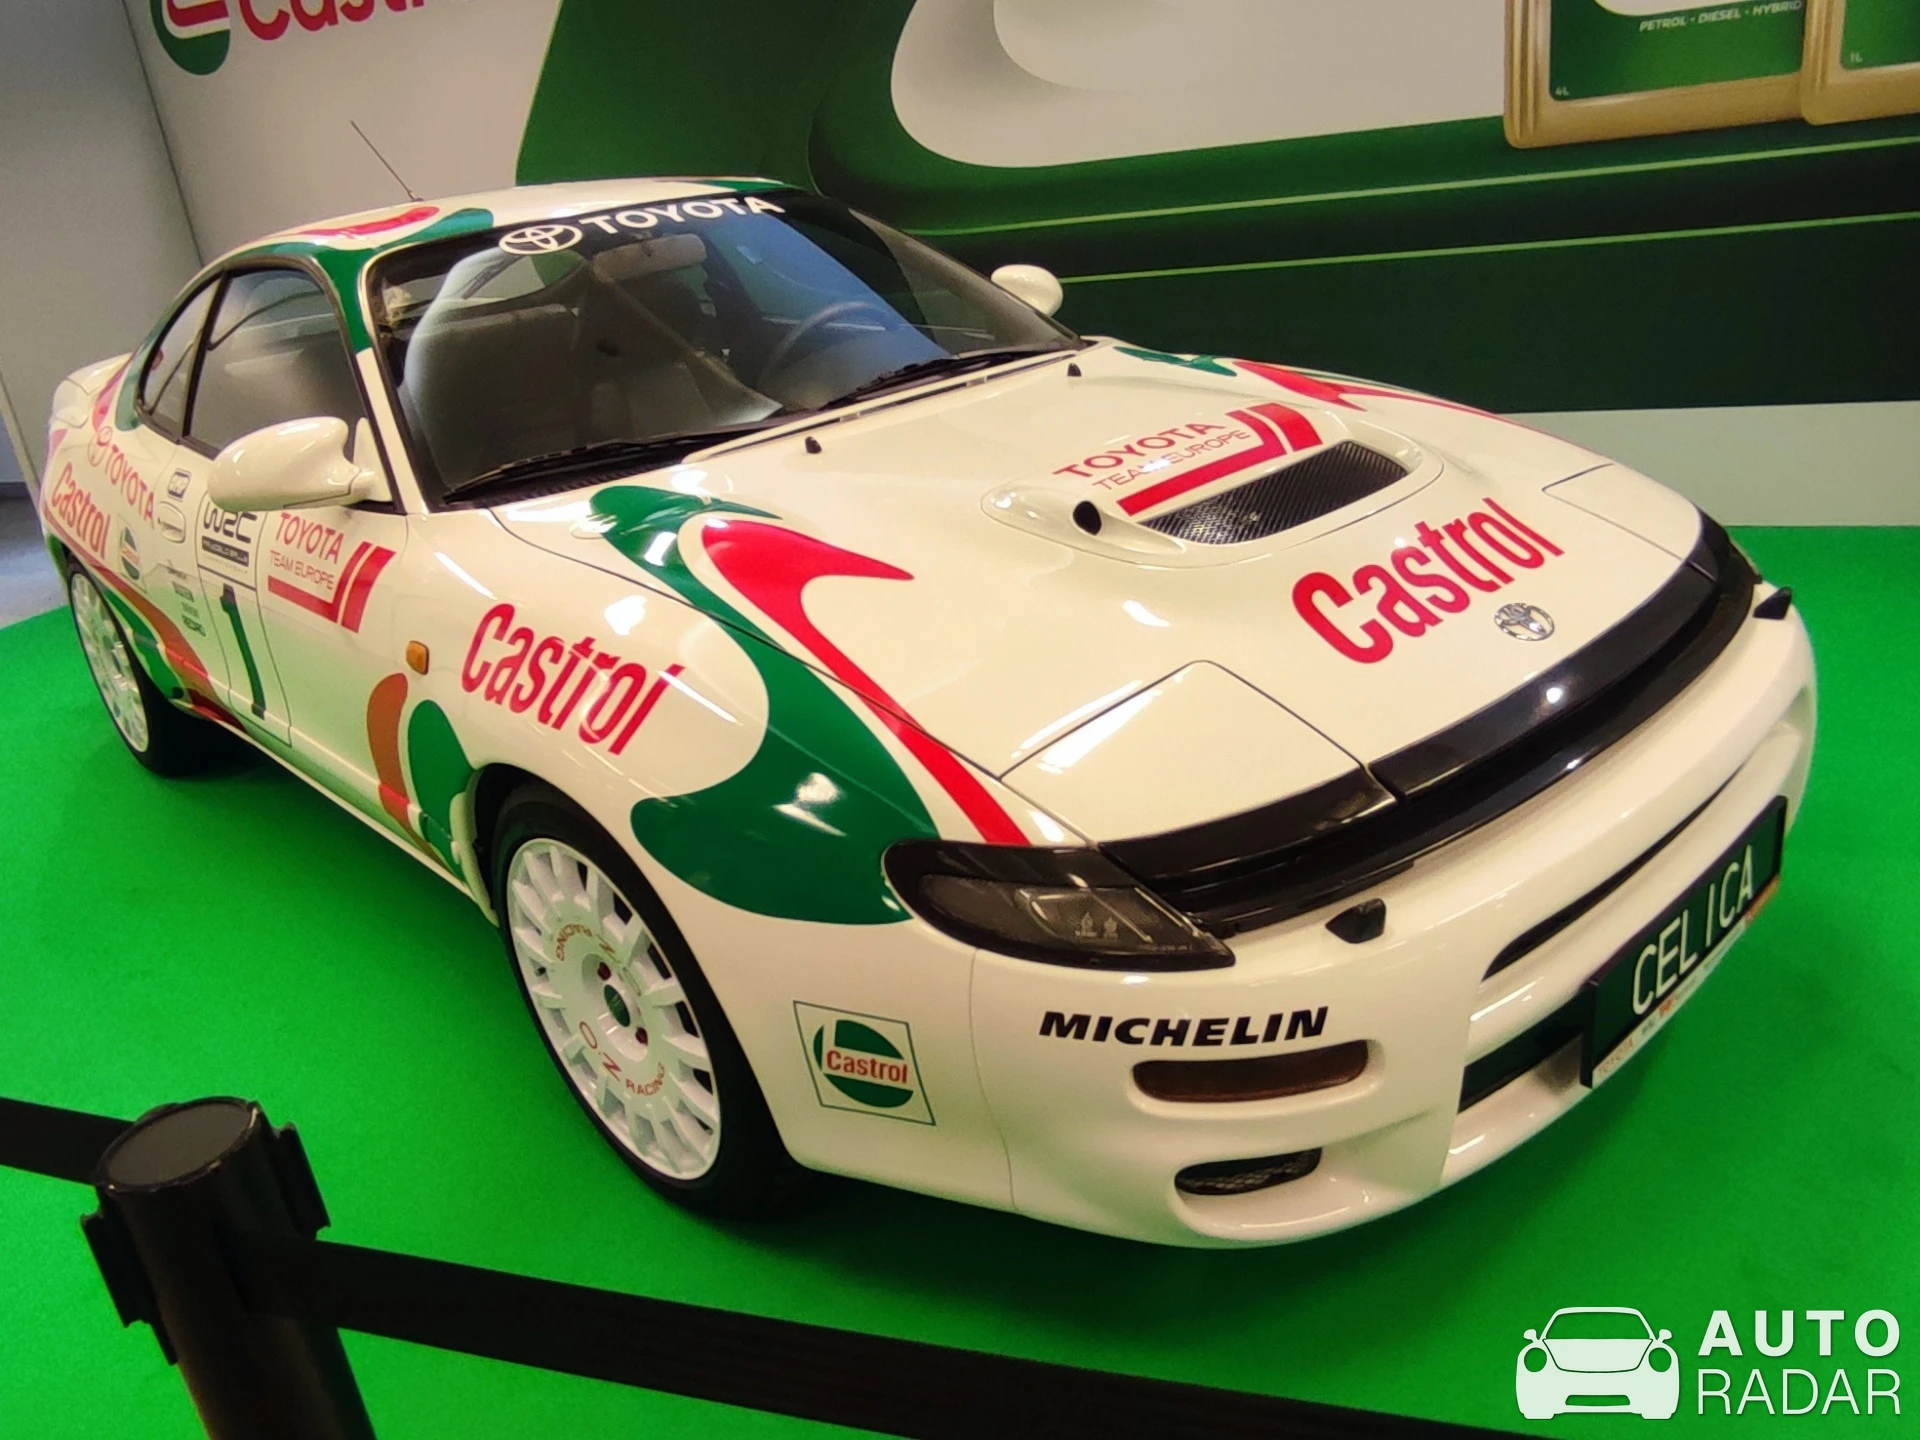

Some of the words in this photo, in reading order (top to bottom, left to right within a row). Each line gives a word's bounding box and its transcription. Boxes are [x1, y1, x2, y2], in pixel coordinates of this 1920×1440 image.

[1640, 18, 1688, 31] PETROL
[1698, 9, 1742, 23] DIESEL
[579, 196, 785, 234] TOYOTA
[1052, 423, 1226, 478] TOYOTA
[1092, 460, 1158, 490] TEA
[1161, 429, 1252, 464] EUROPE
[105, 444, 155, 521] TOYOTA
[52, 462, 111, 560] Castrol
[276, 512, 344, 564] TOYOTA
[270, 550, 294, 568] TEAM
[294, 558, 335, 590] EUROPE
[1292, 497, 1565, 664] Castrol
[219, 582, 266, 721] 1
[461, 603, 686, 756] Castrol
[1039, 1006, 1329, 1047] MICHELIN
[626, 1061, 665, 1097] RACING
[826, 1049, 908, 1084] Castrol
